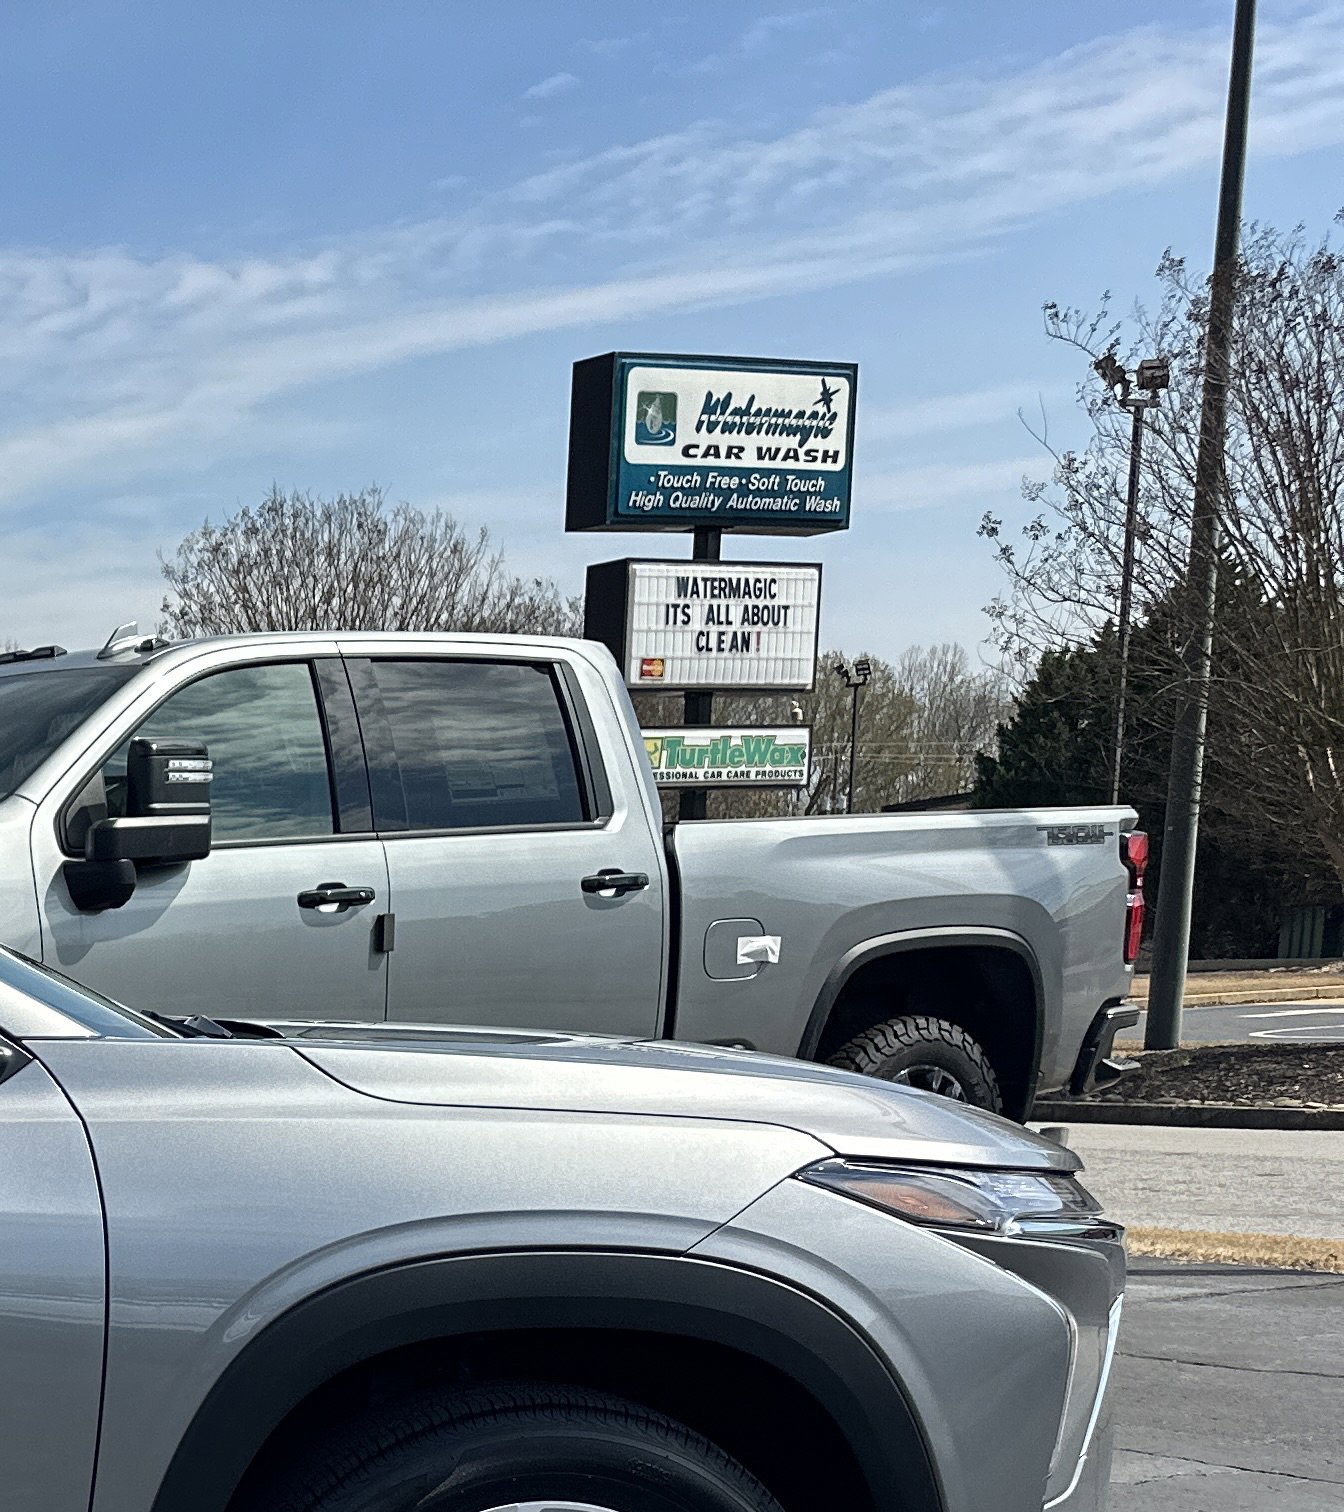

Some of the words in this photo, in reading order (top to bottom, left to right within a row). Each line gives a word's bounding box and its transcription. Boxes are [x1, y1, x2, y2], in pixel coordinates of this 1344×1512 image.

[695, 391, 838, 448] Watermagic
[681, 444, 745, 461] CAR
[756, 446, 840, 464] WASH
[657, 471, 700, 489] Touch
[748, 474, 779, 491] Soft
[785, 475, 825, 492] Touch
[628, 490, 663, 510] High
[669, 491, 722, 512] Quality
[726, 492, 800, 512] Automatic
[804, 495, 841, 513] Wash
[676, 576, 777, 600] WATERMAGIC
[665, 604, 691, 626] ITS
[705, 604, 733, 626] ALL
[741, 605, 790, 627] ABOUT
[703, 770, 722, 780] CAR
[726, 769, 751, 780] CARE
[755, 768, 804, 780] PRODUCTS
